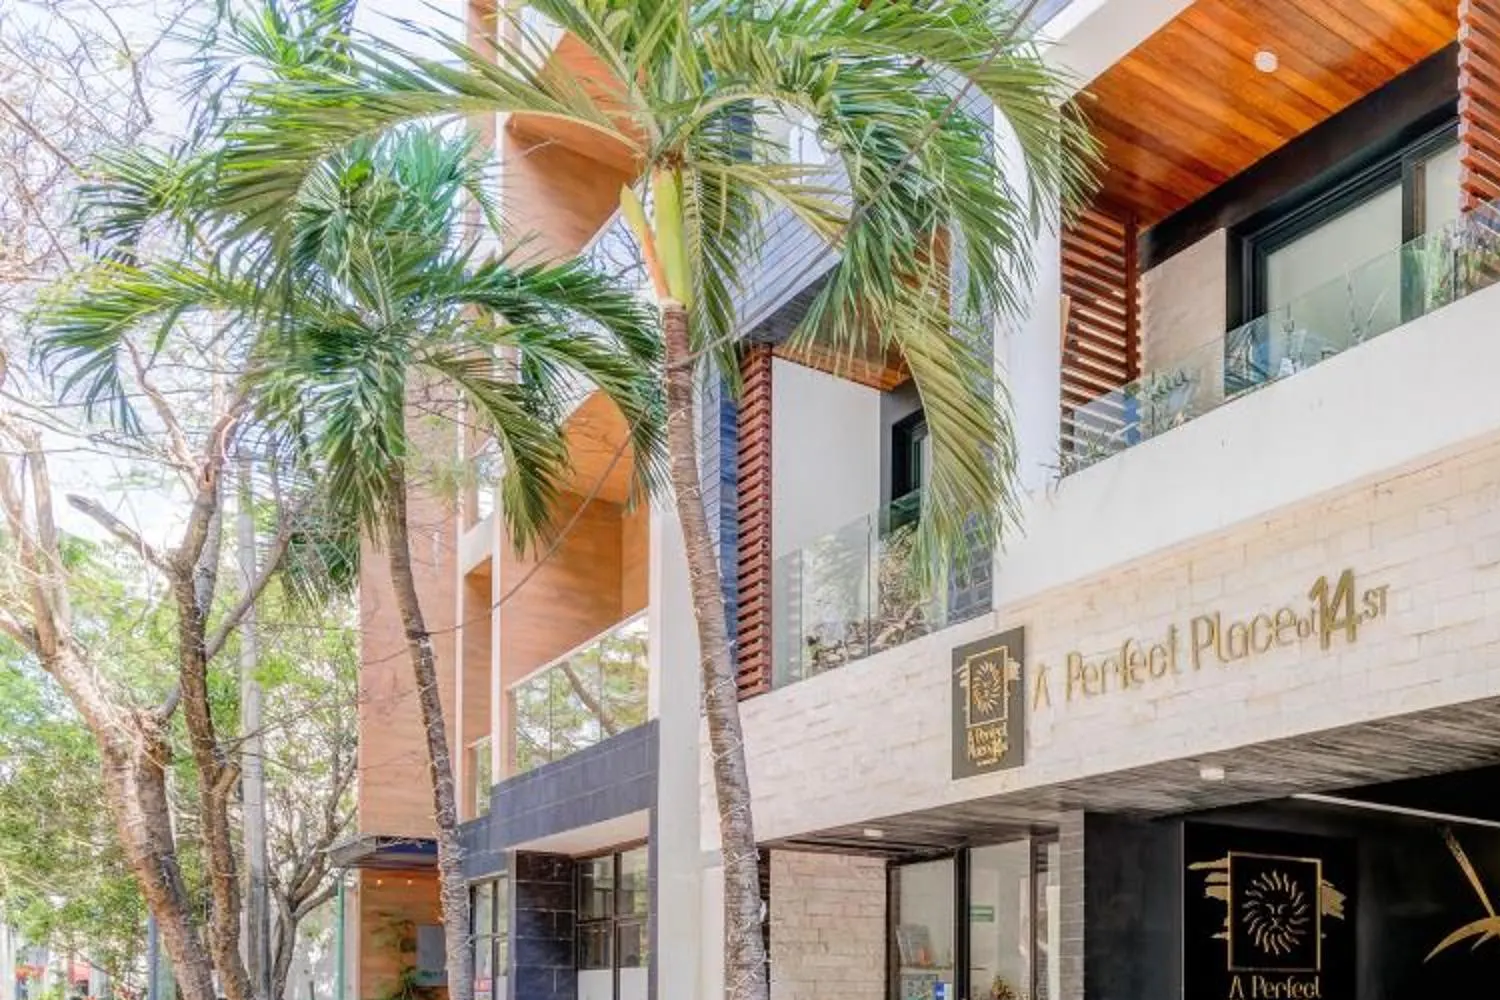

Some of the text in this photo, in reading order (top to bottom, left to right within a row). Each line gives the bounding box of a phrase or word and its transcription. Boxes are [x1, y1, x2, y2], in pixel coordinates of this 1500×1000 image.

[1032, 664, 1051, 713] A
[1065, 624, 1179, 701] Perfect
[1190, 609, 1298, 671] Place
[1229, 975, 1321, 998] A Perfect
